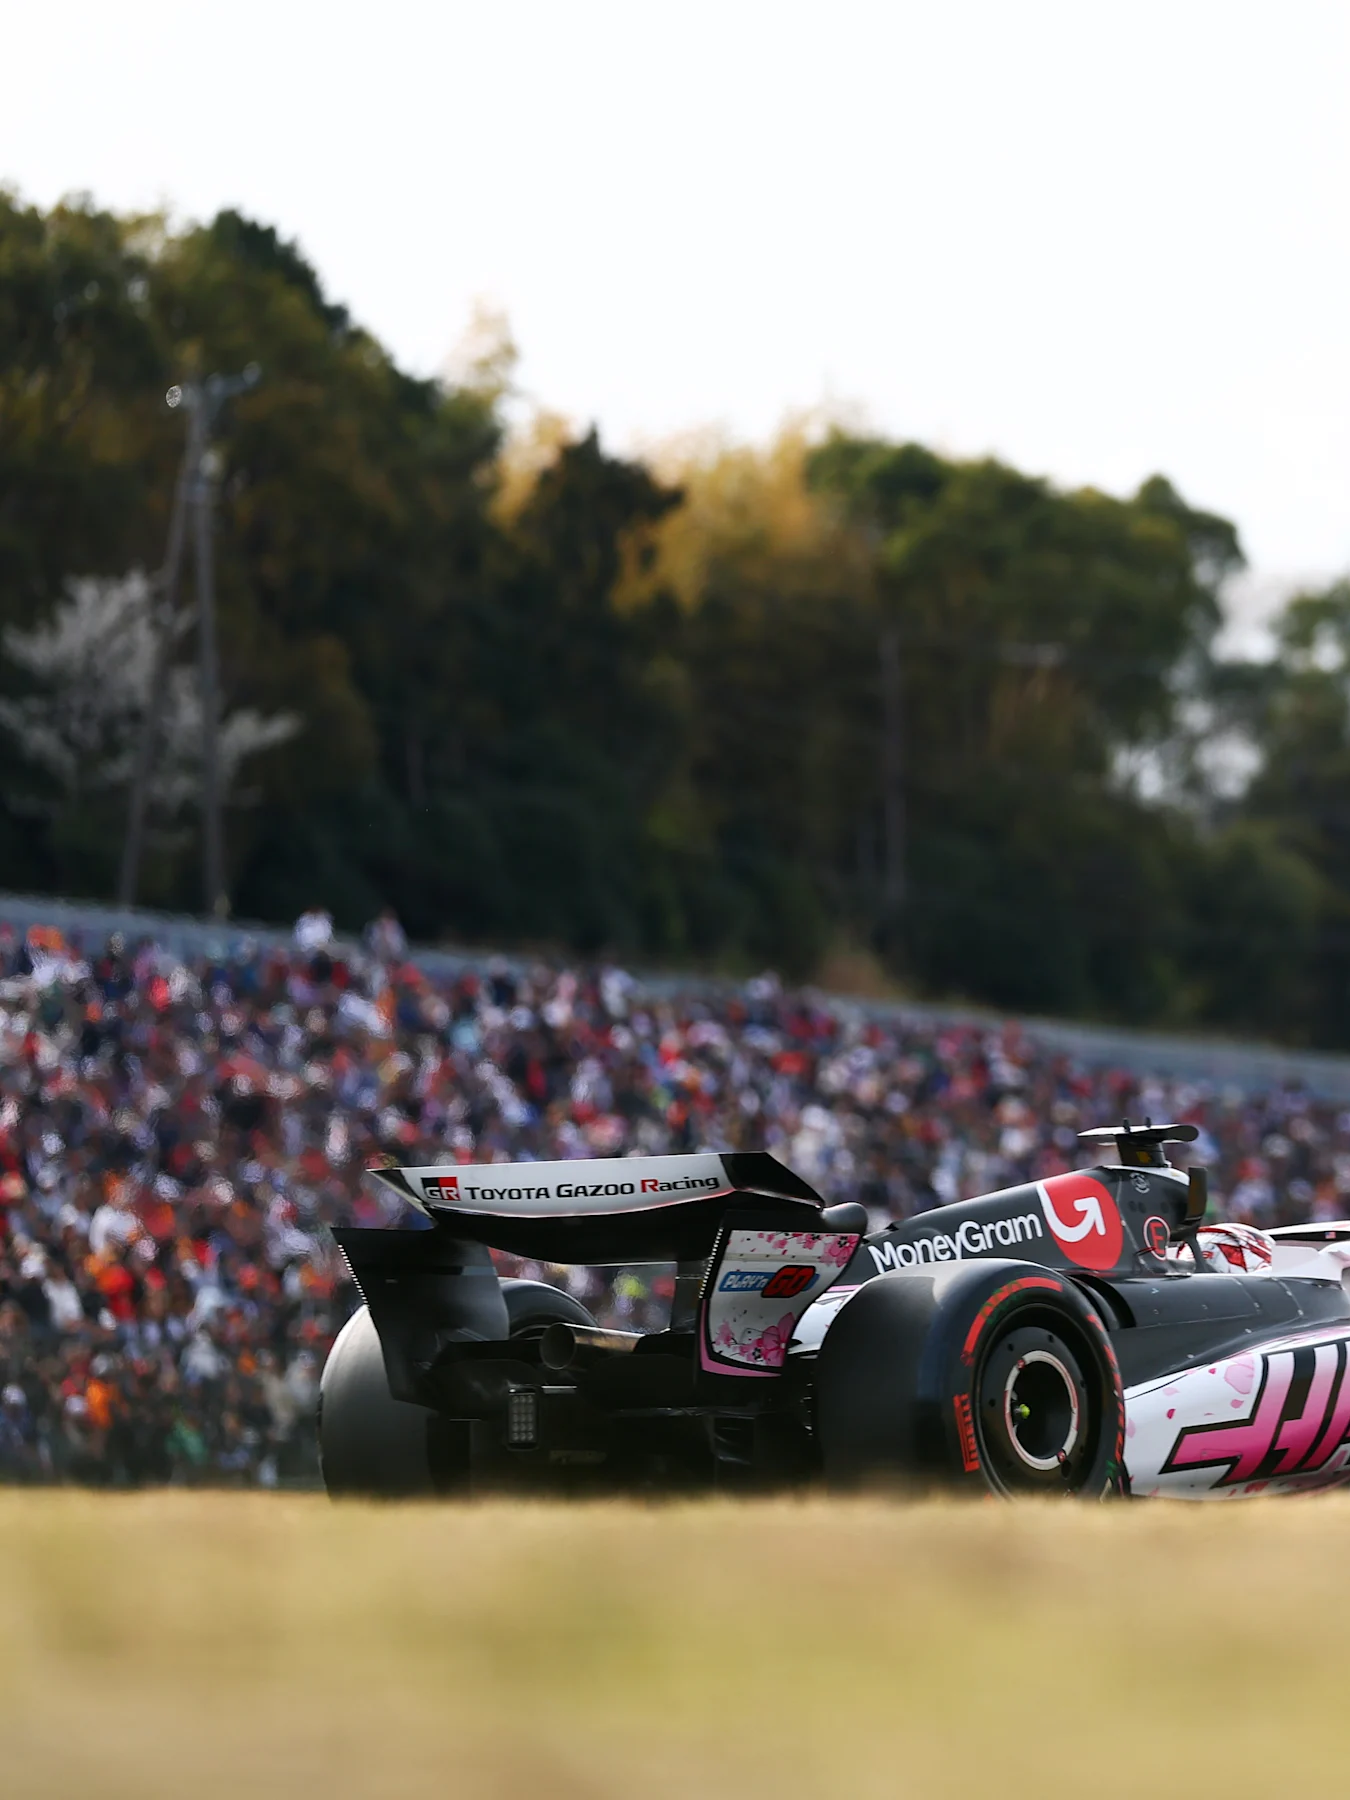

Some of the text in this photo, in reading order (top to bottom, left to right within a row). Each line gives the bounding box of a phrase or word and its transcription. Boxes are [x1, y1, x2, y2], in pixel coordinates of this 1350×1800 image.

[425, 1186, 459, 1200] GR
[465, 1176, 720, 1200] TOYOTA GAZOO Racing
[868, 1213, 1043, 1274] MoneyGram
[762, 1266, 815, 1298] GO
